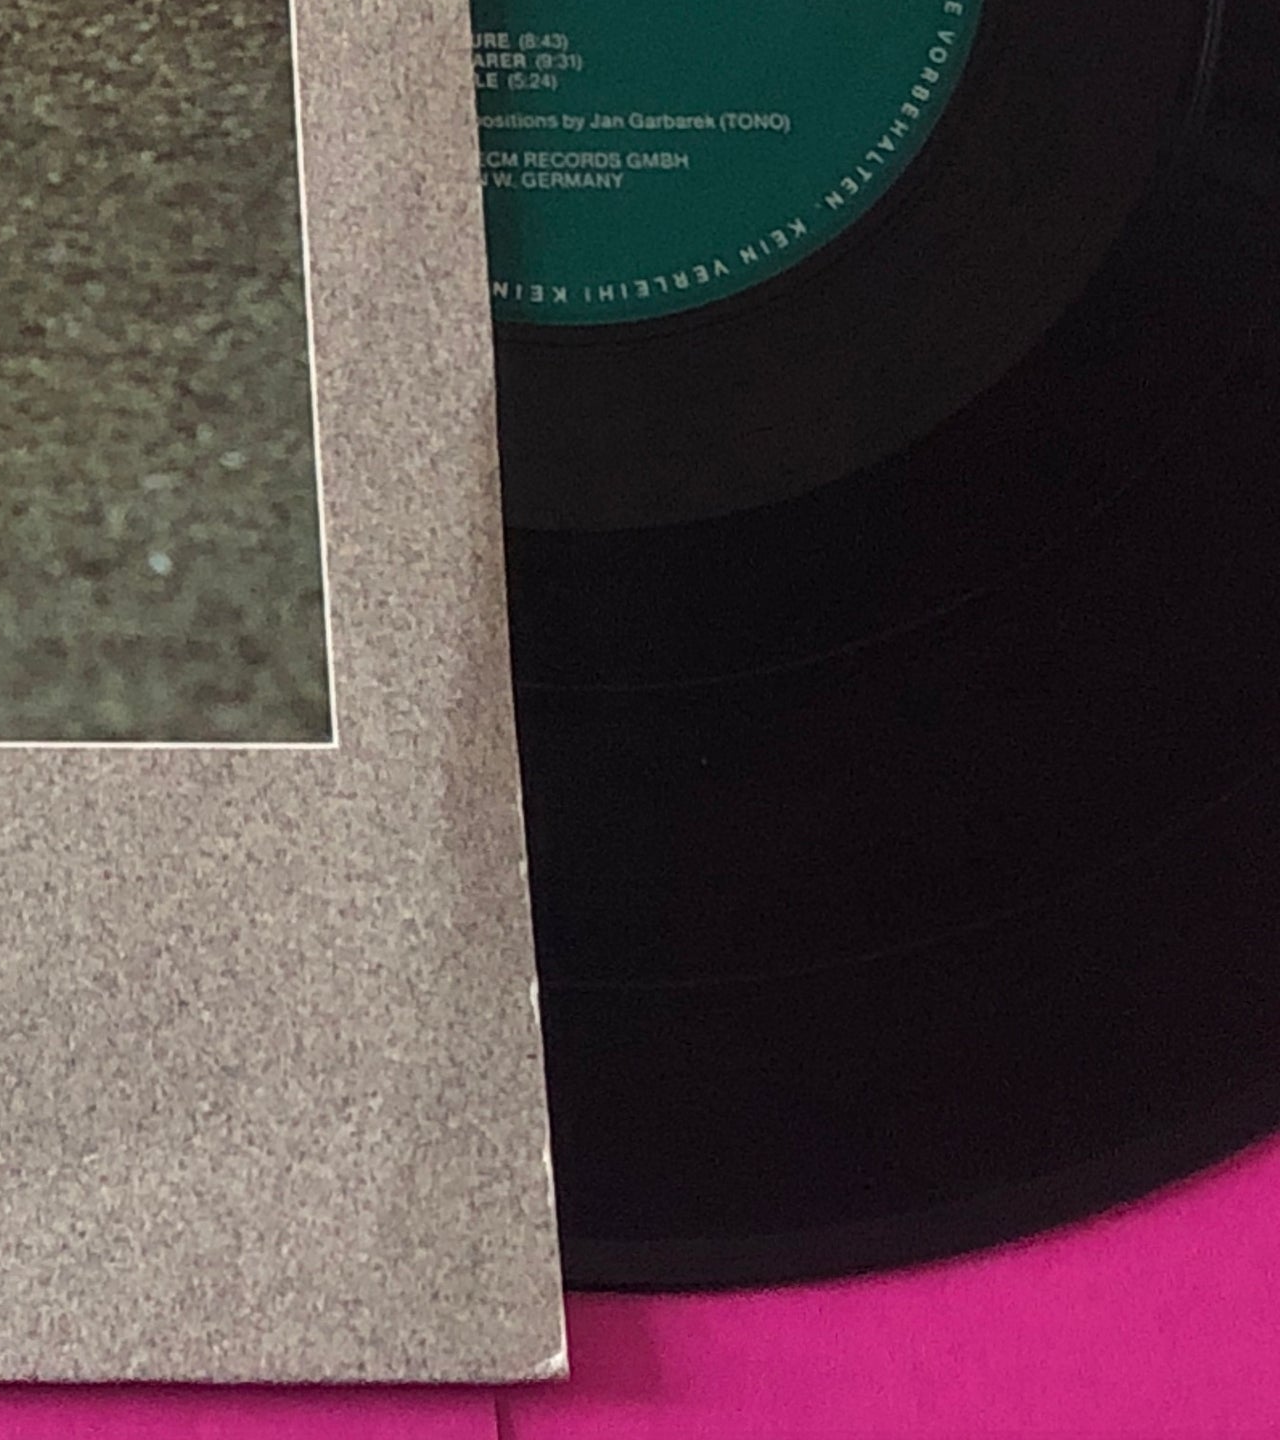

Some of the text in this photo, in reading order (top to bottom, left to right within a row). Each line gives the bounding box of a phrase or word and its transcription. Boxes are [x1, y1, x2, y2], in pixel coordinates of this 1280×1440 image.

[472, 32, 510, 49] URE
[474, 52, 527, 69] ARER
[475, 72, 499, 89] LE
[479, 112, 791, 134] ositions by Jan Garbarek (TONO)
[523, 151, 622, 168] RECORDS
[626, 151, 690, 169] GMBH
[521, 171, 624, 188] GERMANY
[738, 217, 808, 265] KEIN
